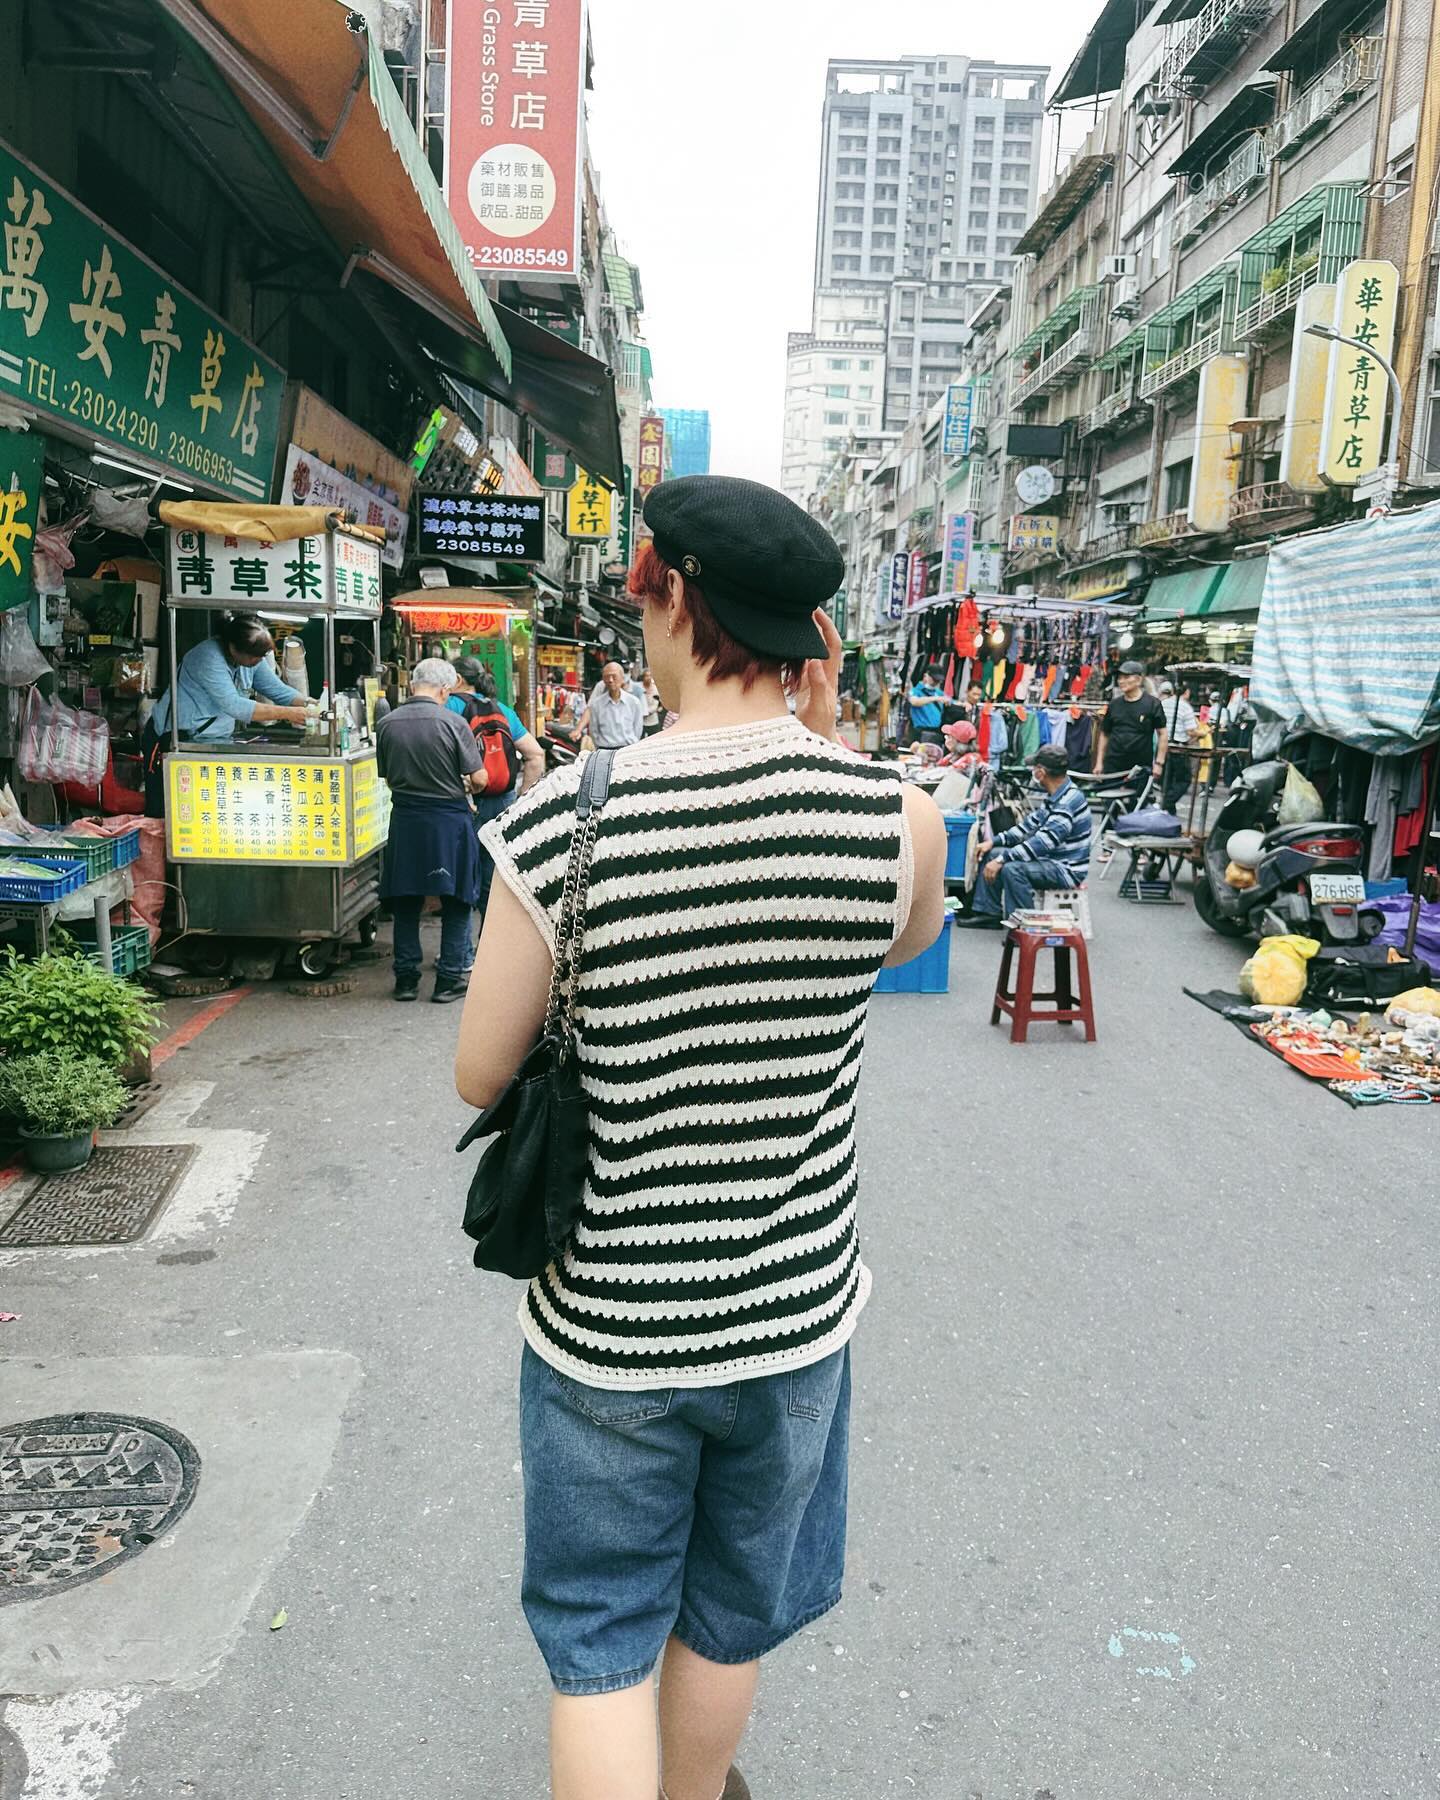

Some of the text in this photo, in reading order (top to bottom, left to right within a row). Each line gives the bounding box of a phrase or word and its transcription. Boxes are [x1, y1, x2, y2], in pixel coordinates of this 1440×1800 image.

[482, 8, 501, 66] Grass
[480, 72, 499, 126] Store
[480, 161, 545, 178] 藥材販售
[480, 182, 545, 199] 御膳湯品
[0, 176, 265, 457] 萬安青草店
[1335, 277, 1383, 468] 華安青草店
[436, 539, 525, 555] 23085549
[200, 766, 212, 825] 青草茶
[232, 766, 244, 825] 養生茶
[248, 767, 260, 826] 苦茶
[297, 768, 309, 828] 冬瓜茶
[313, 769, 325, 828] 蒲公英
